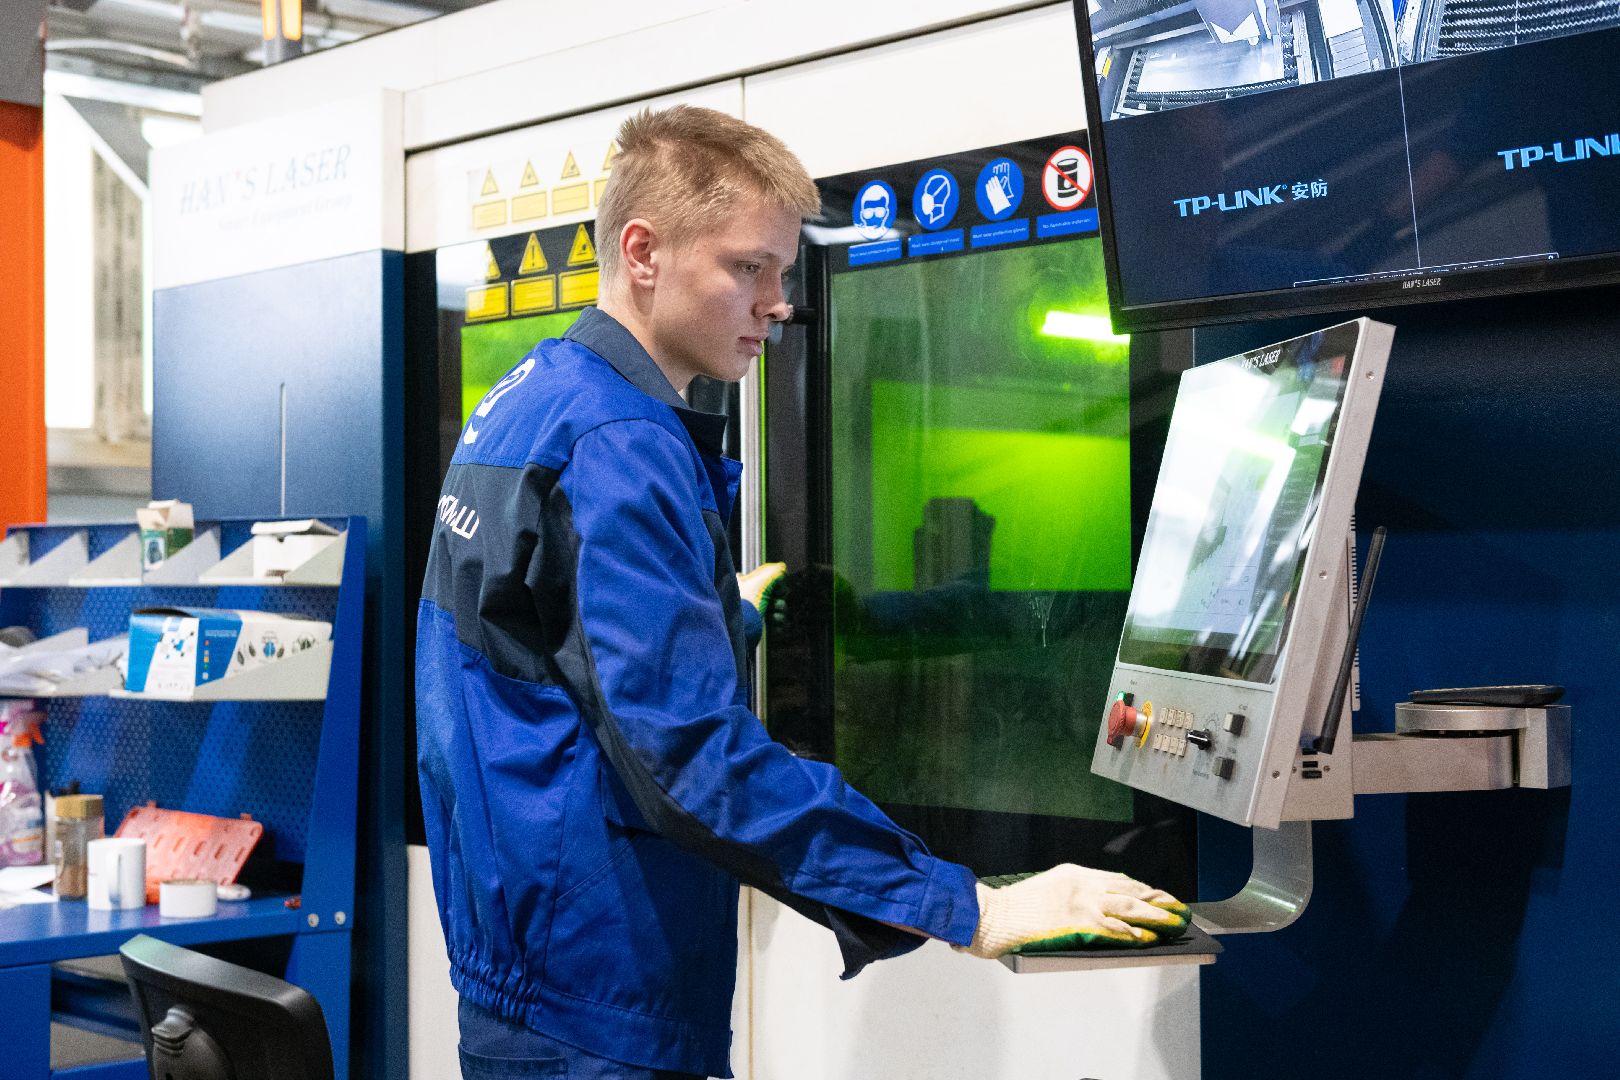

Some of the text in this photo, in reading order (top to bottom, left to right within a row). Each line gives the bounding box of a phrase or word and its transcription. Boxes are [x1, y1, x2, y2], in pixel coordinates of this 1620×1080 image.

[264, 143, 351, 196] LASER
[1291, 178, 1328, 201] 安防
[1422, 277, 1442, 287] LASER
